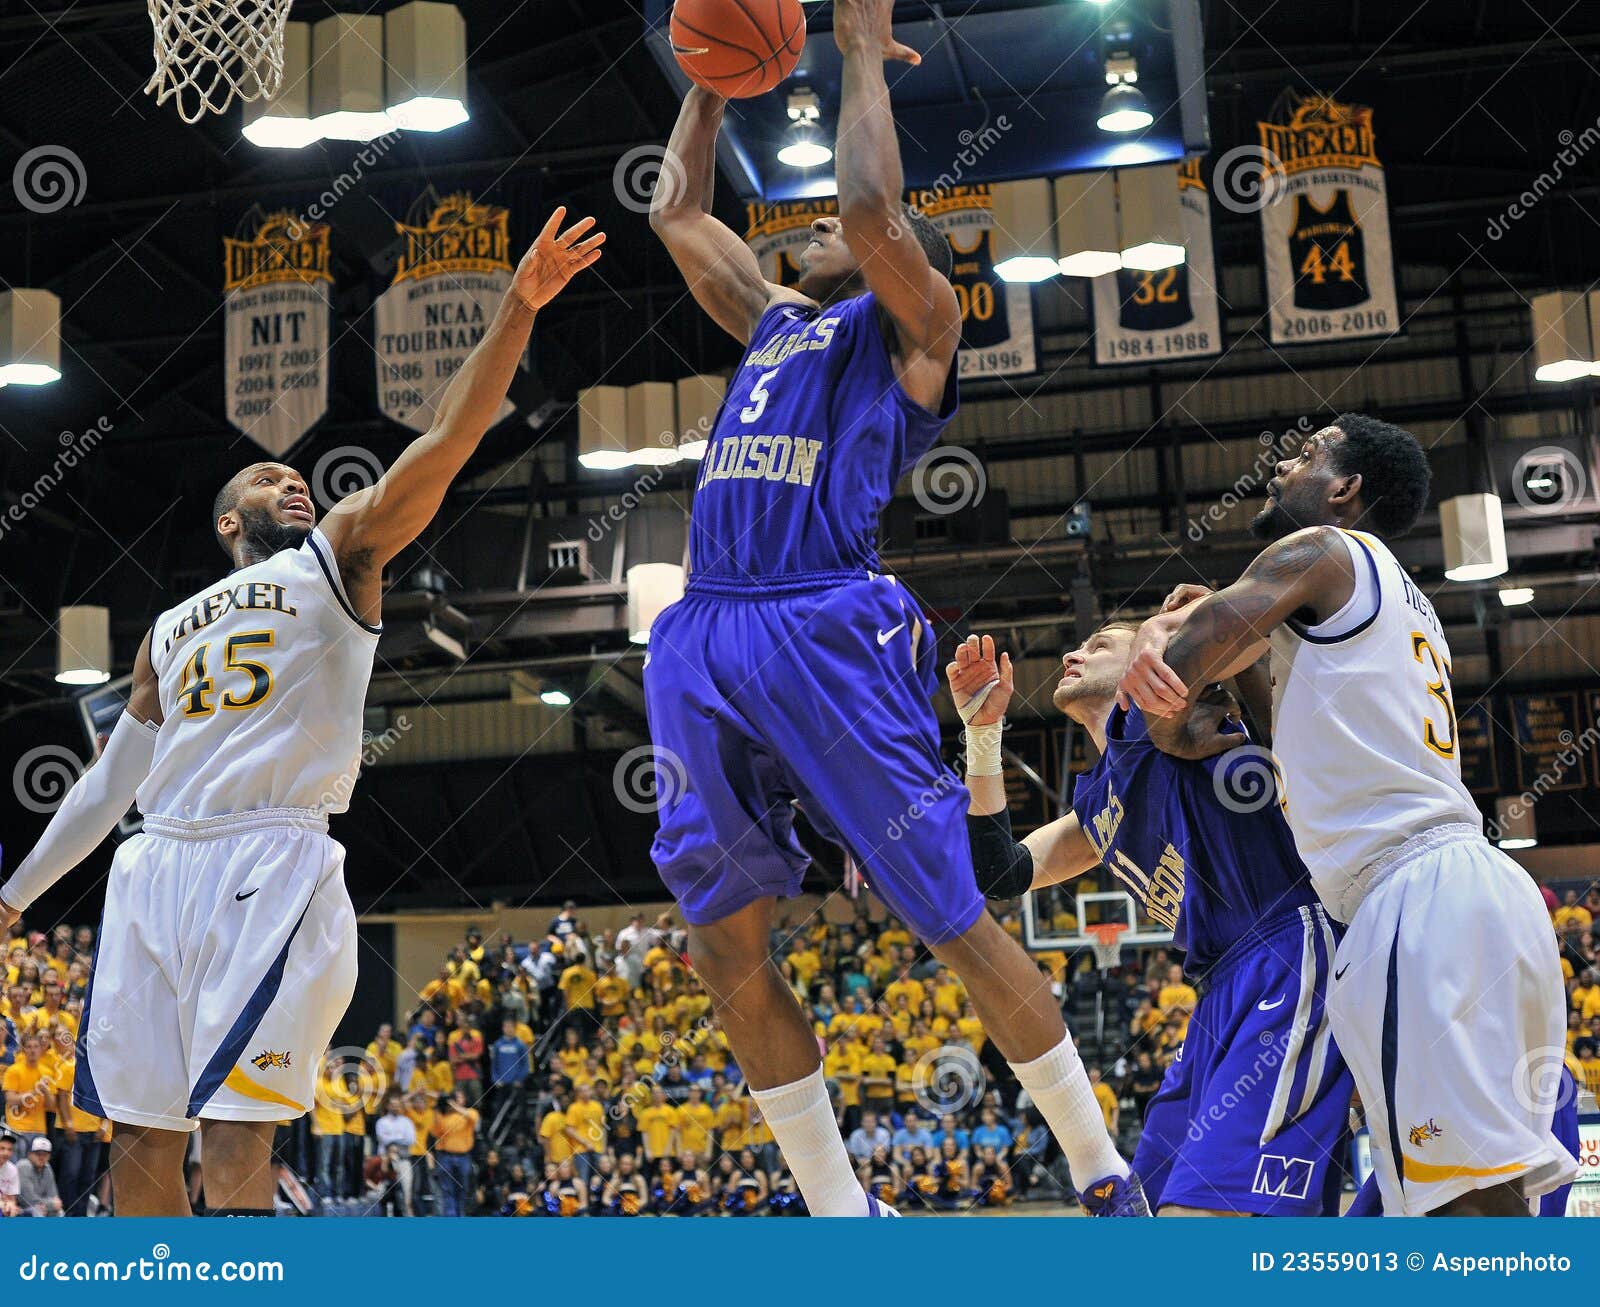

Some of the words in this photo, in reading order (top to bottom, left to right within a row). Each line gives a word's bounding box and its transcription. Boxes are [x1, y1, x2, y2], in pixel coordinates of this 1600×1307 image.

[1301, 241, 1356, 285] 44
[1131, 267, 1179, 306] 32
[251, 311, 306, 347] NIT
[424, 302, 484, 327] NCAA
[1282, 309, 1388, 337] 2006-2010
[381, 324, 487, 355] TOURNAM
[1108, 332, 1210, 360] 1984-1988
[382, 360, 423, 384] 1986
[435, 356, 464, 379] 199
[959, 349, 1023, 374] 2-1996
[235, 374, 275, 396] 2004
[739, 367, 779, 424] 5
[697, 435, 823, 492] ADISON
[176, 629, 275, 718] 45
[1410, 631, 1456, 760] 3
[1109, 848, 1151, 904] 11
